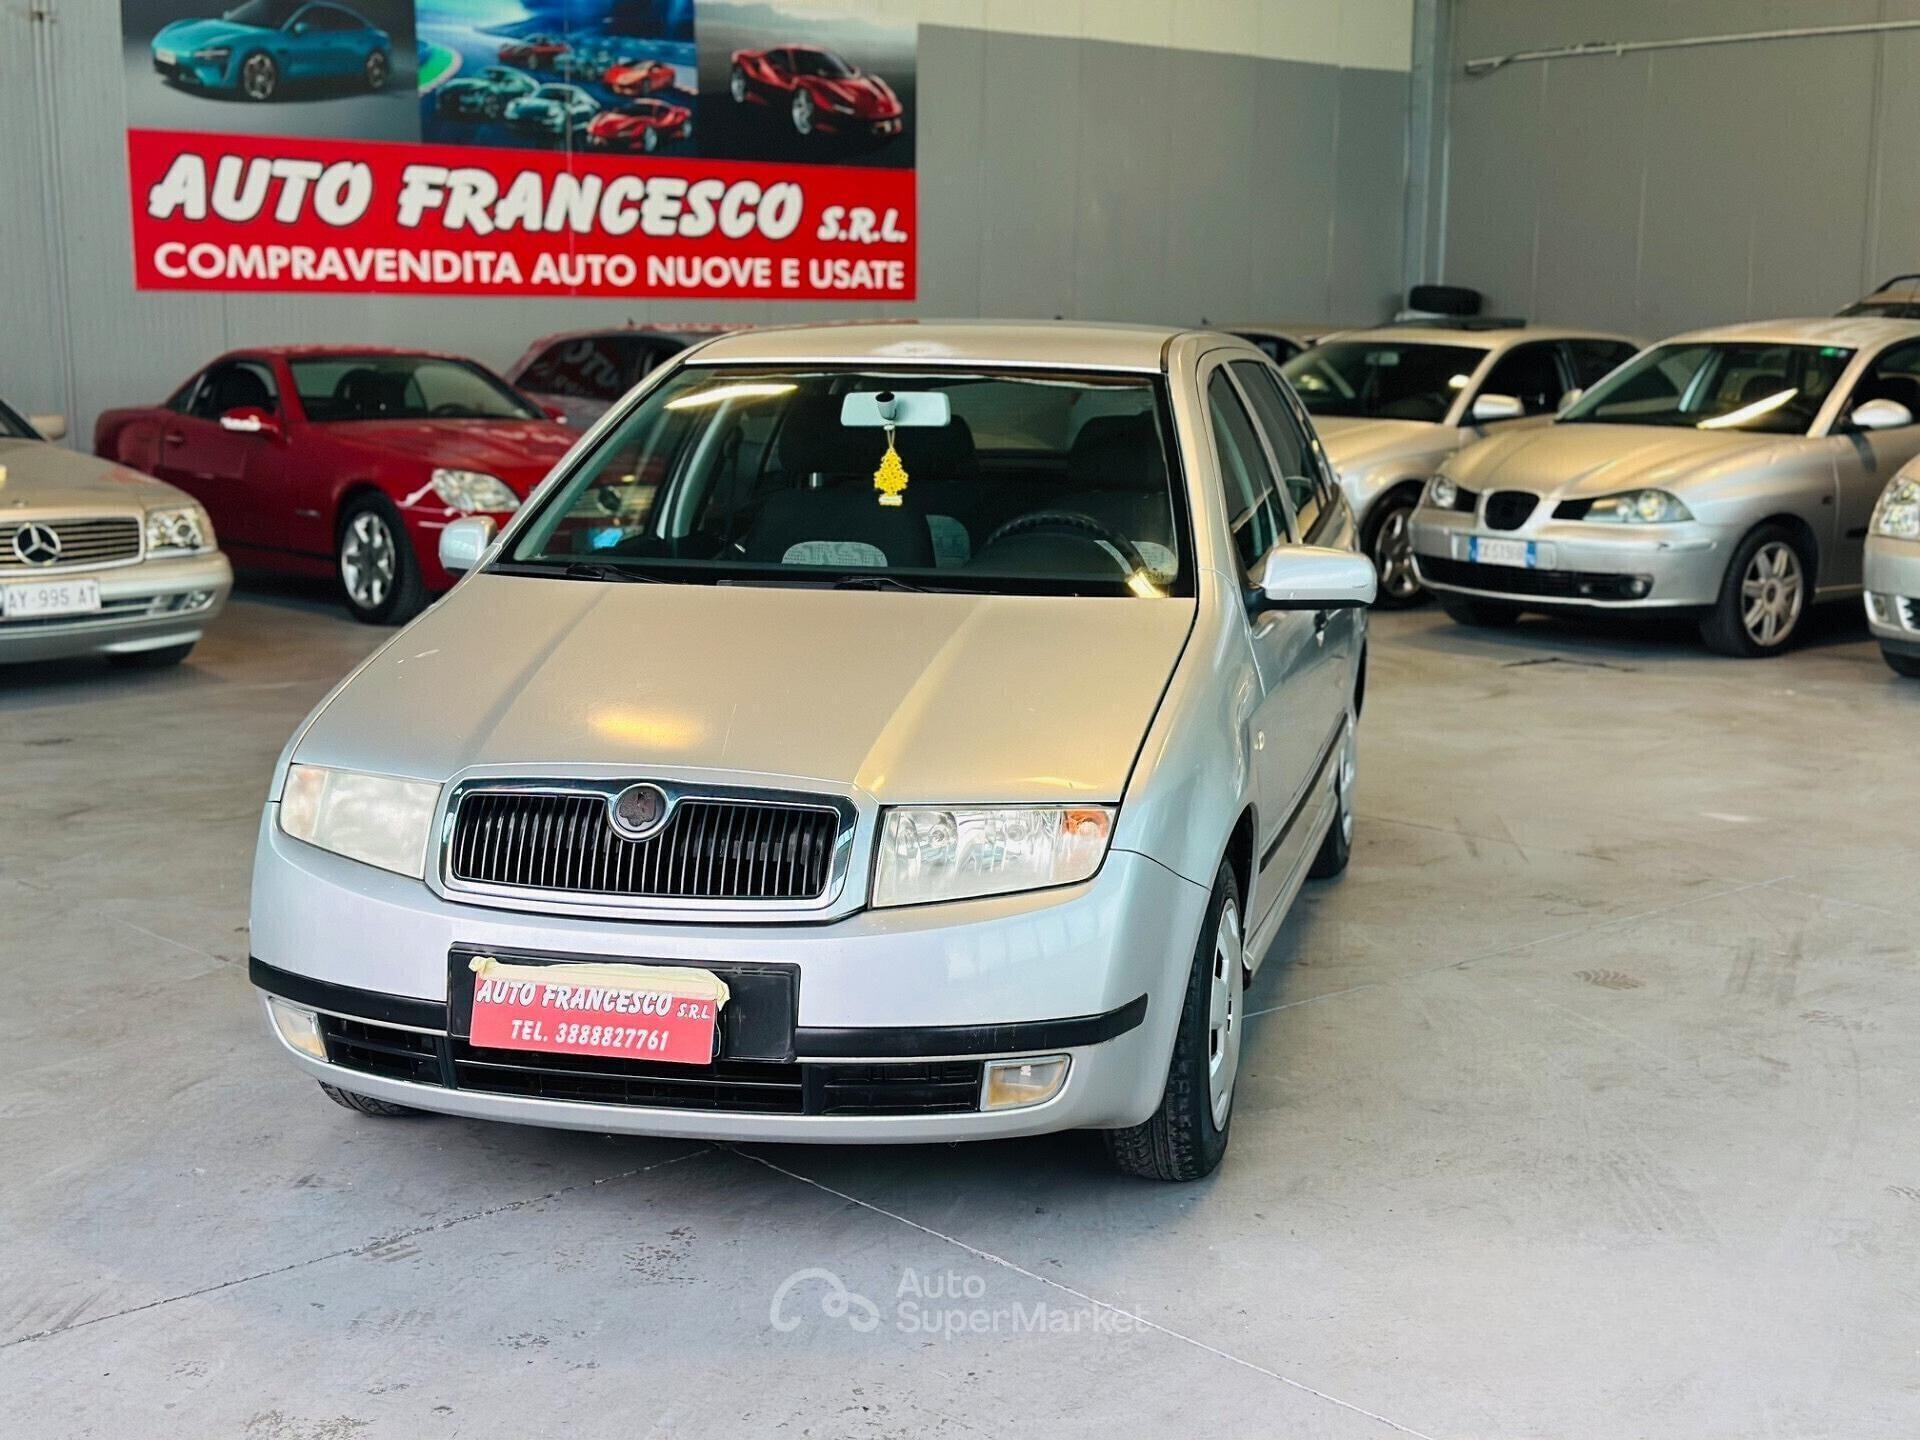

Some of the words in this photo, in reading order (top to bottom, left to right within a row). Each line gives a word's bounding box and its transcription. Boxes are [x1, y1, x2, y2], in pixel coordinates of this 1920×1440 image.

[147, 153, 373, 226] AUTO
[397, 164, 803, 239] FRANCESCO
[817, 205, 908, 244] S.R.L.
[153, 242, 522, 284] COMPRAVENDITA
[531, 252, 637, 287] AUTO
[646, 255, 772, 288] NUOVE
[780, 258, 800, 288] E
[808, 259, 905, 290] USATE
[475, 979, 536, 1006] AUTO
[541, 982, 674, 1016] FRANCESCO
[510, 1019, 549, 1043] TEL.
[555, 1023, 669, 1051] 3888827761
